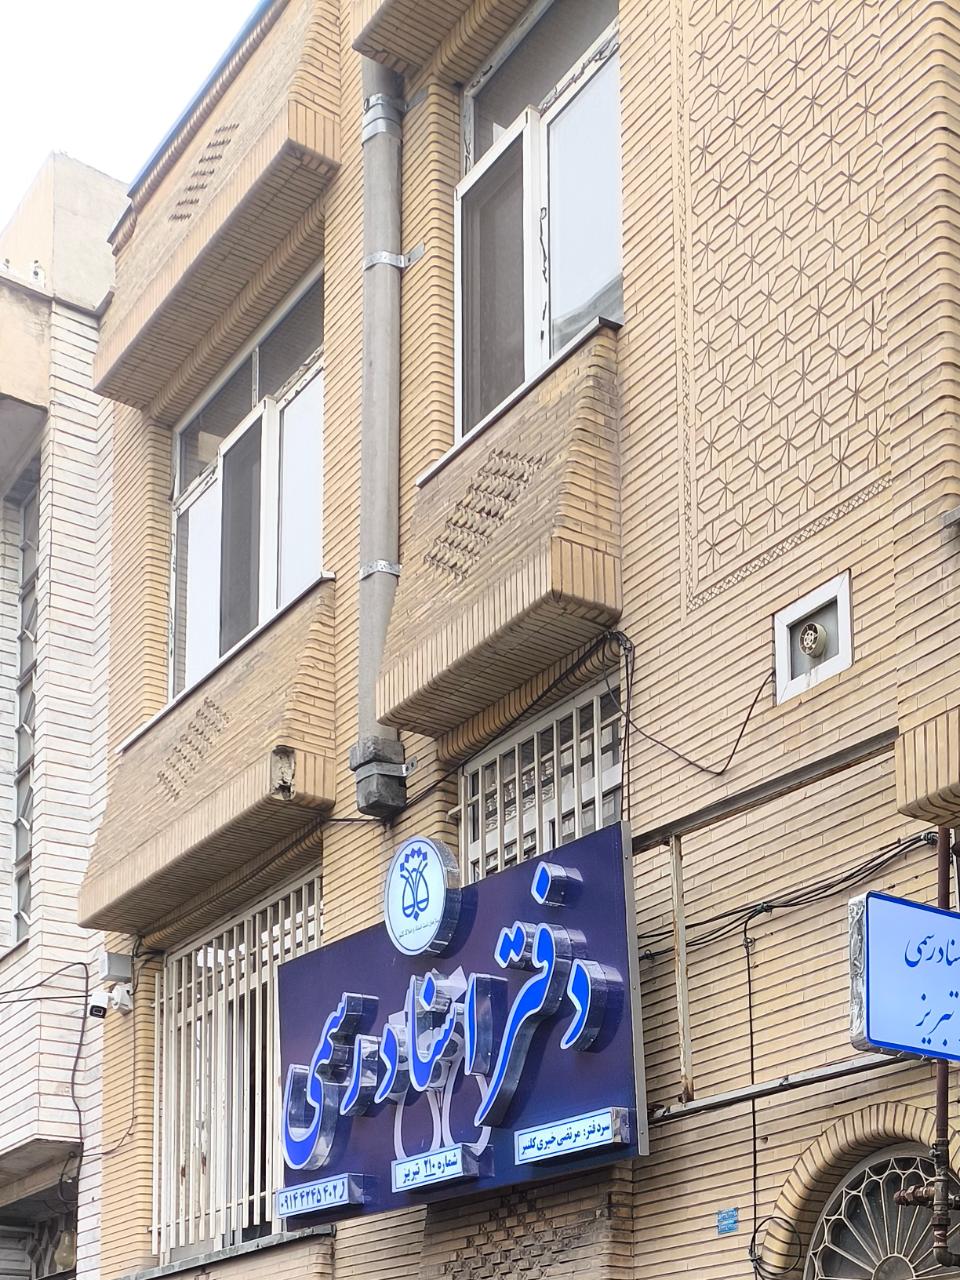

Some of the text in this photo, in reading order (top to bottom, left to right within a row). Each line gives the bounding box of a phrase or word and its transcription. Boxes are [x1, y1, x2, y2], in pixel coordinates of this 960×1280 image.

[904, 933, 936, 968] رسمی
[282, 861, 594, 1170] دفتر اسناد رسمی
[915, 990, 960, 1047] تبریز
[556, 1127, 581, 1147] مرتضی
[402, 1152, 458, 1184] شماره ۲۱۰ تبریز
